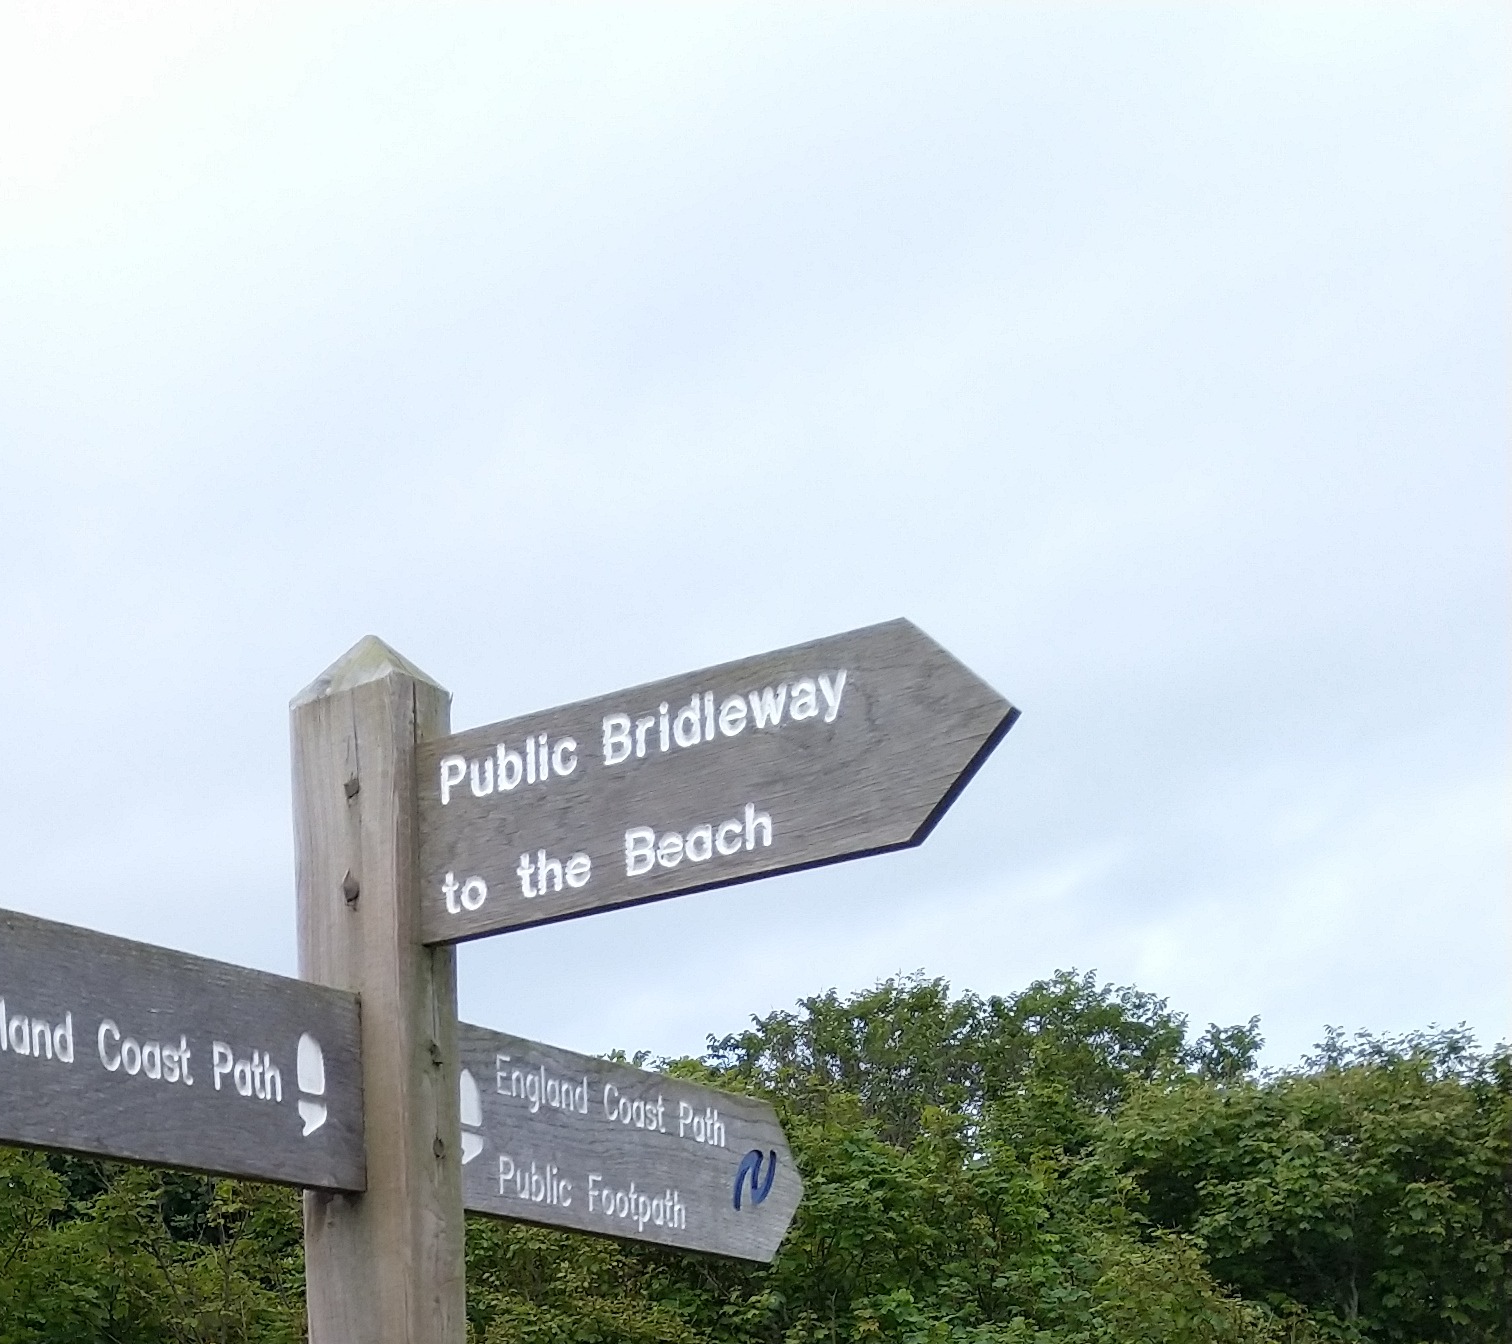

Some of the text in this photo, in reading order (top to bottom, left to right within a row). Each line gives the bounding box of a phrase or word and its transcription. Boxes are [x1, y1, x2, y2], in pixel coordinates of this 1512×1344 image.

[440, 669, 848, 805] Public Bridleway
[441, 803, 773, 914] to the Beach
[97, 1019, 193, 1086] Coast
[212, 1042, 282, 1102] Path
[496, 1054, 726, 1147] England Coast Path
[499, 1156, 686, 1232] Public Footpath
